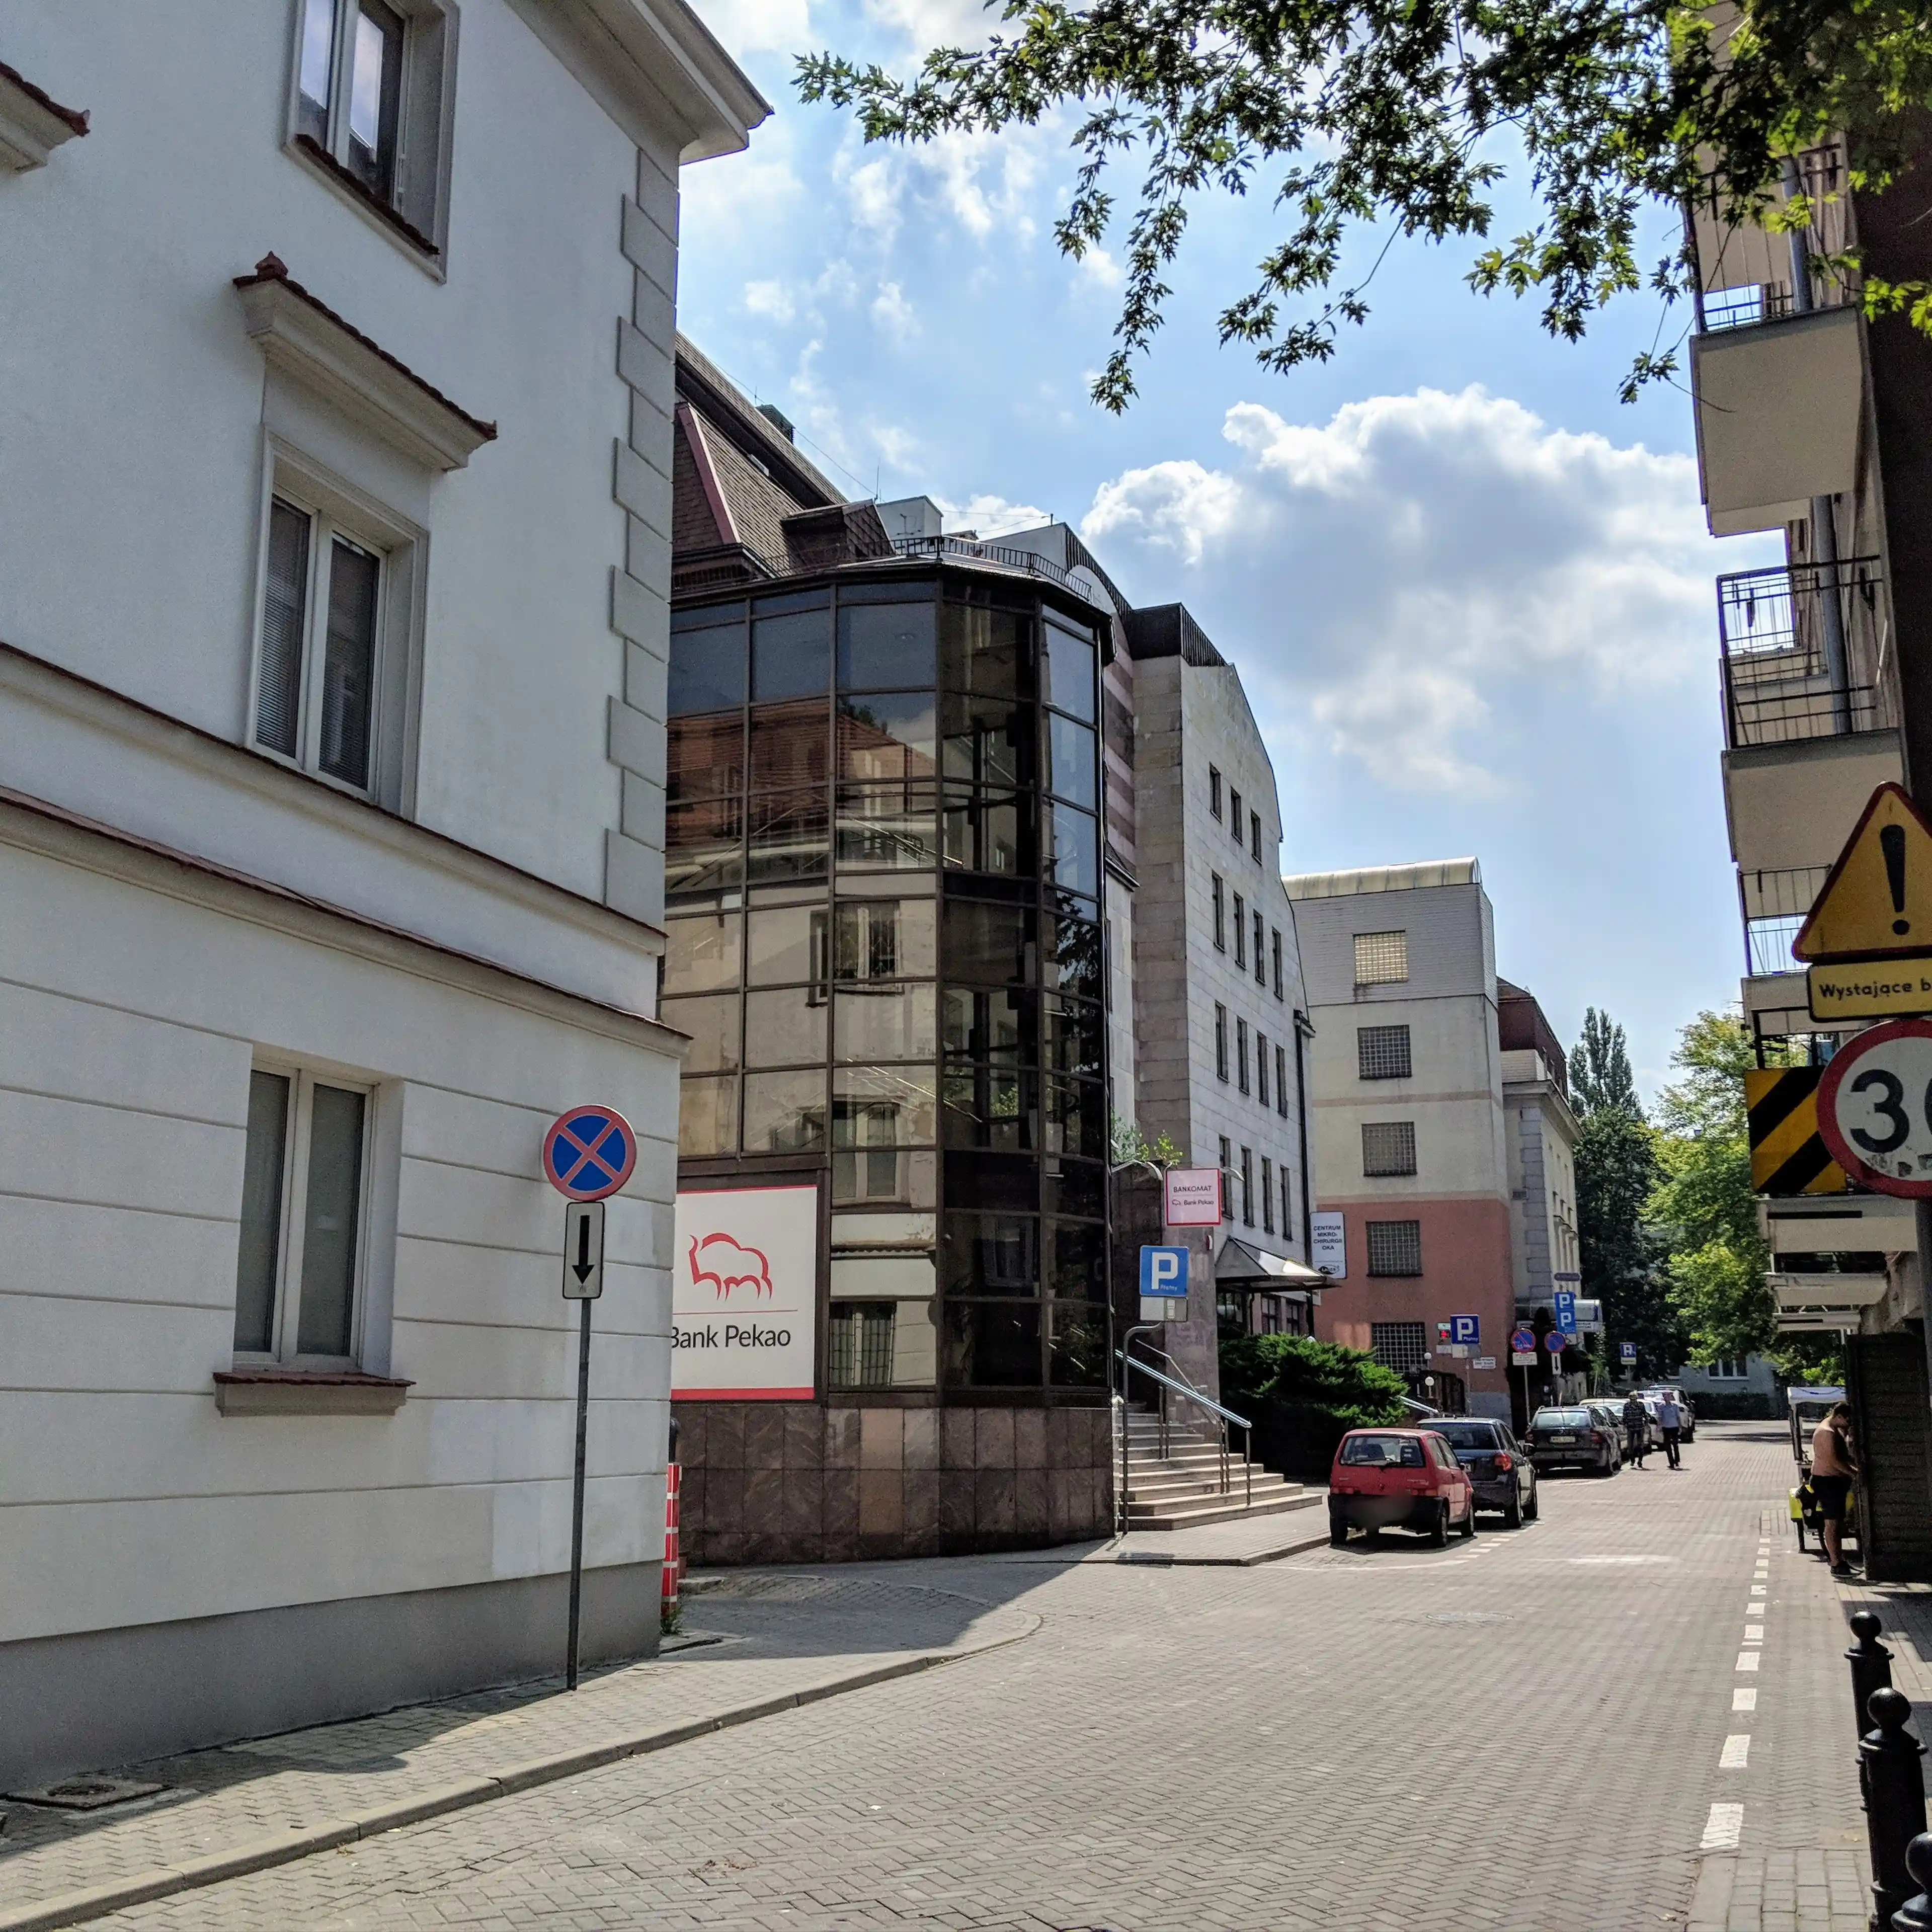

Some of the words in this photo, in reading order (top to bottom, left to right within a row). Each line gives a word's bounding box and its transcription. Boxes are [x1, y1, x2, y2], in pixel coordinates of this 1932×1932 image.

[1818, 981, 1912, 1002] Wystające
[1849, 1069, 1932, 1154] 3
[1151, 1252, 1178, 1290] P
[1559, 1294, 1570, 1308] P
[1457, 1318, 1473, 1341] P
[1560, 1312, 1572, 1327] P
[725, 1324, 791, 1347] Pekao
